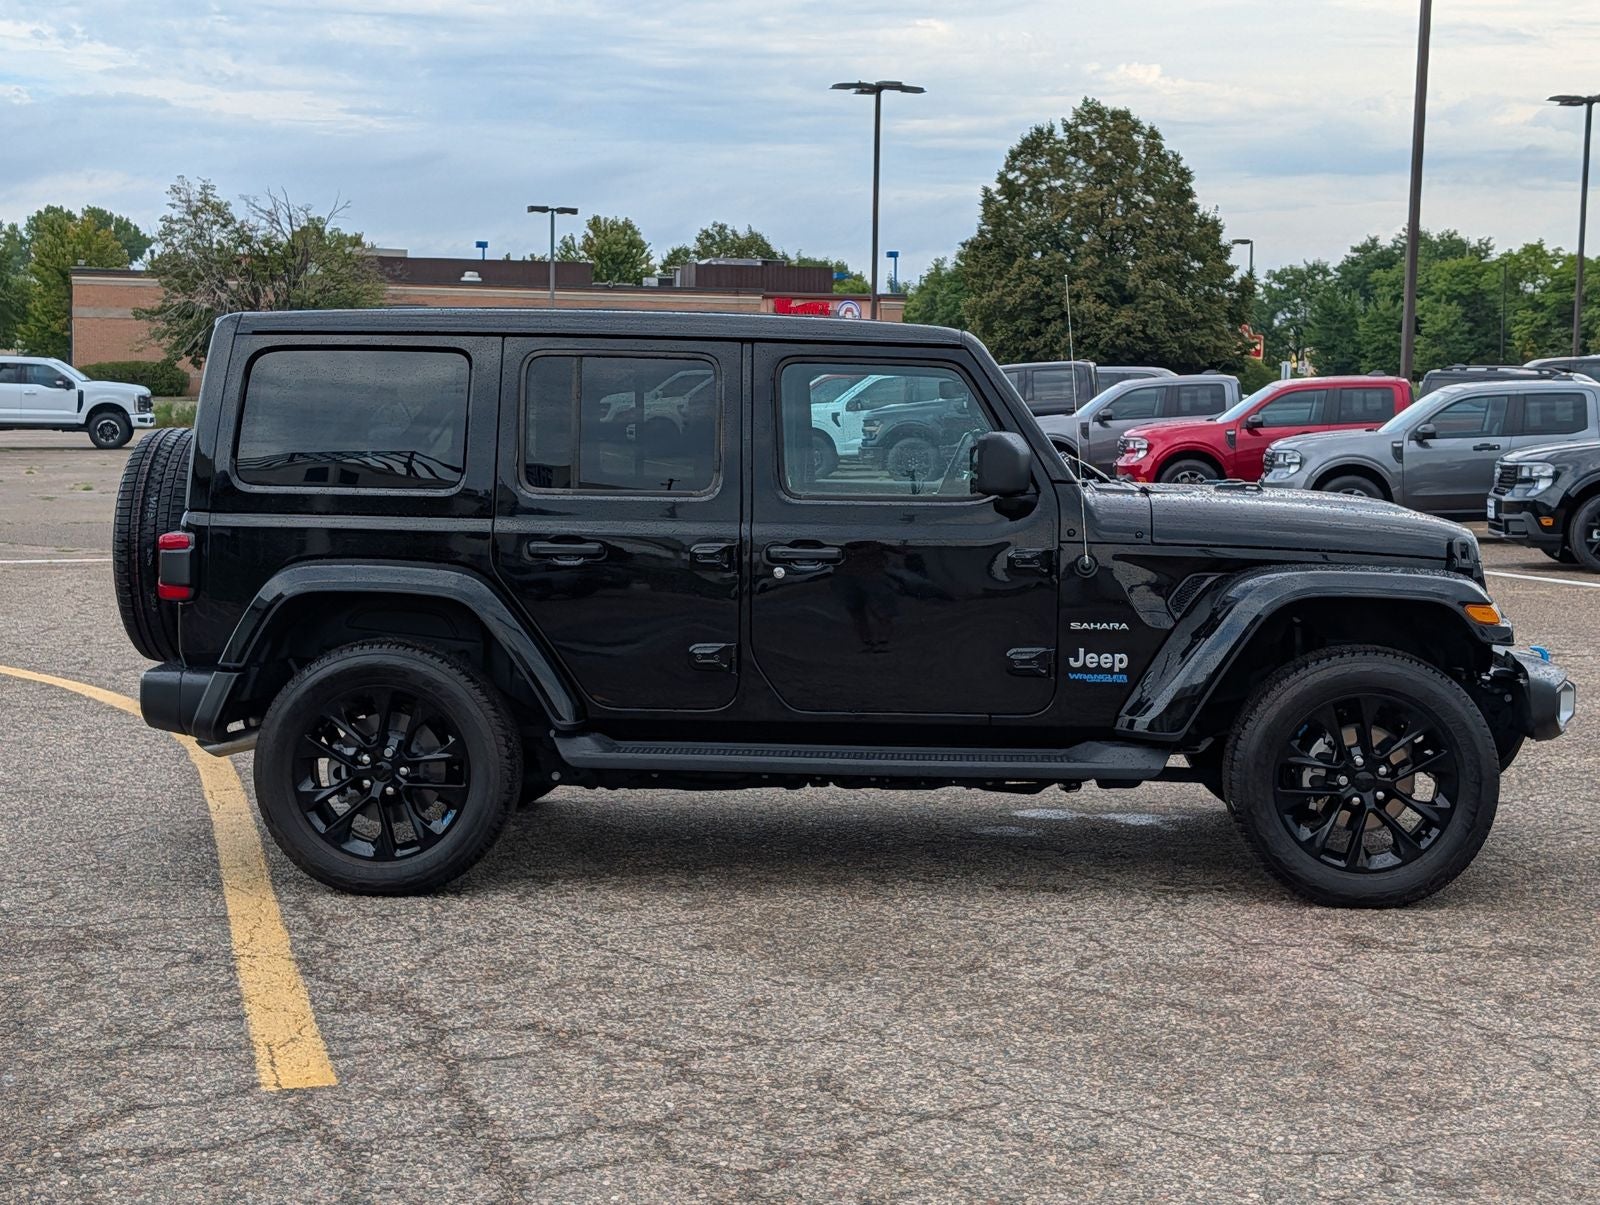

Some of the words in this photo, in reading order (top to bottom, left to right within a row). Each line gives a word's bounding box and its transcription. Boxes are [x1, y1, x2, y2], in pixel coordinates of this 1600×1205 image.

[1069, 622, 1130, 630] SAHARA
[1068, 647, 1129, 672] Jeep
[1068, 672, 1128, 681] WRANGLER
